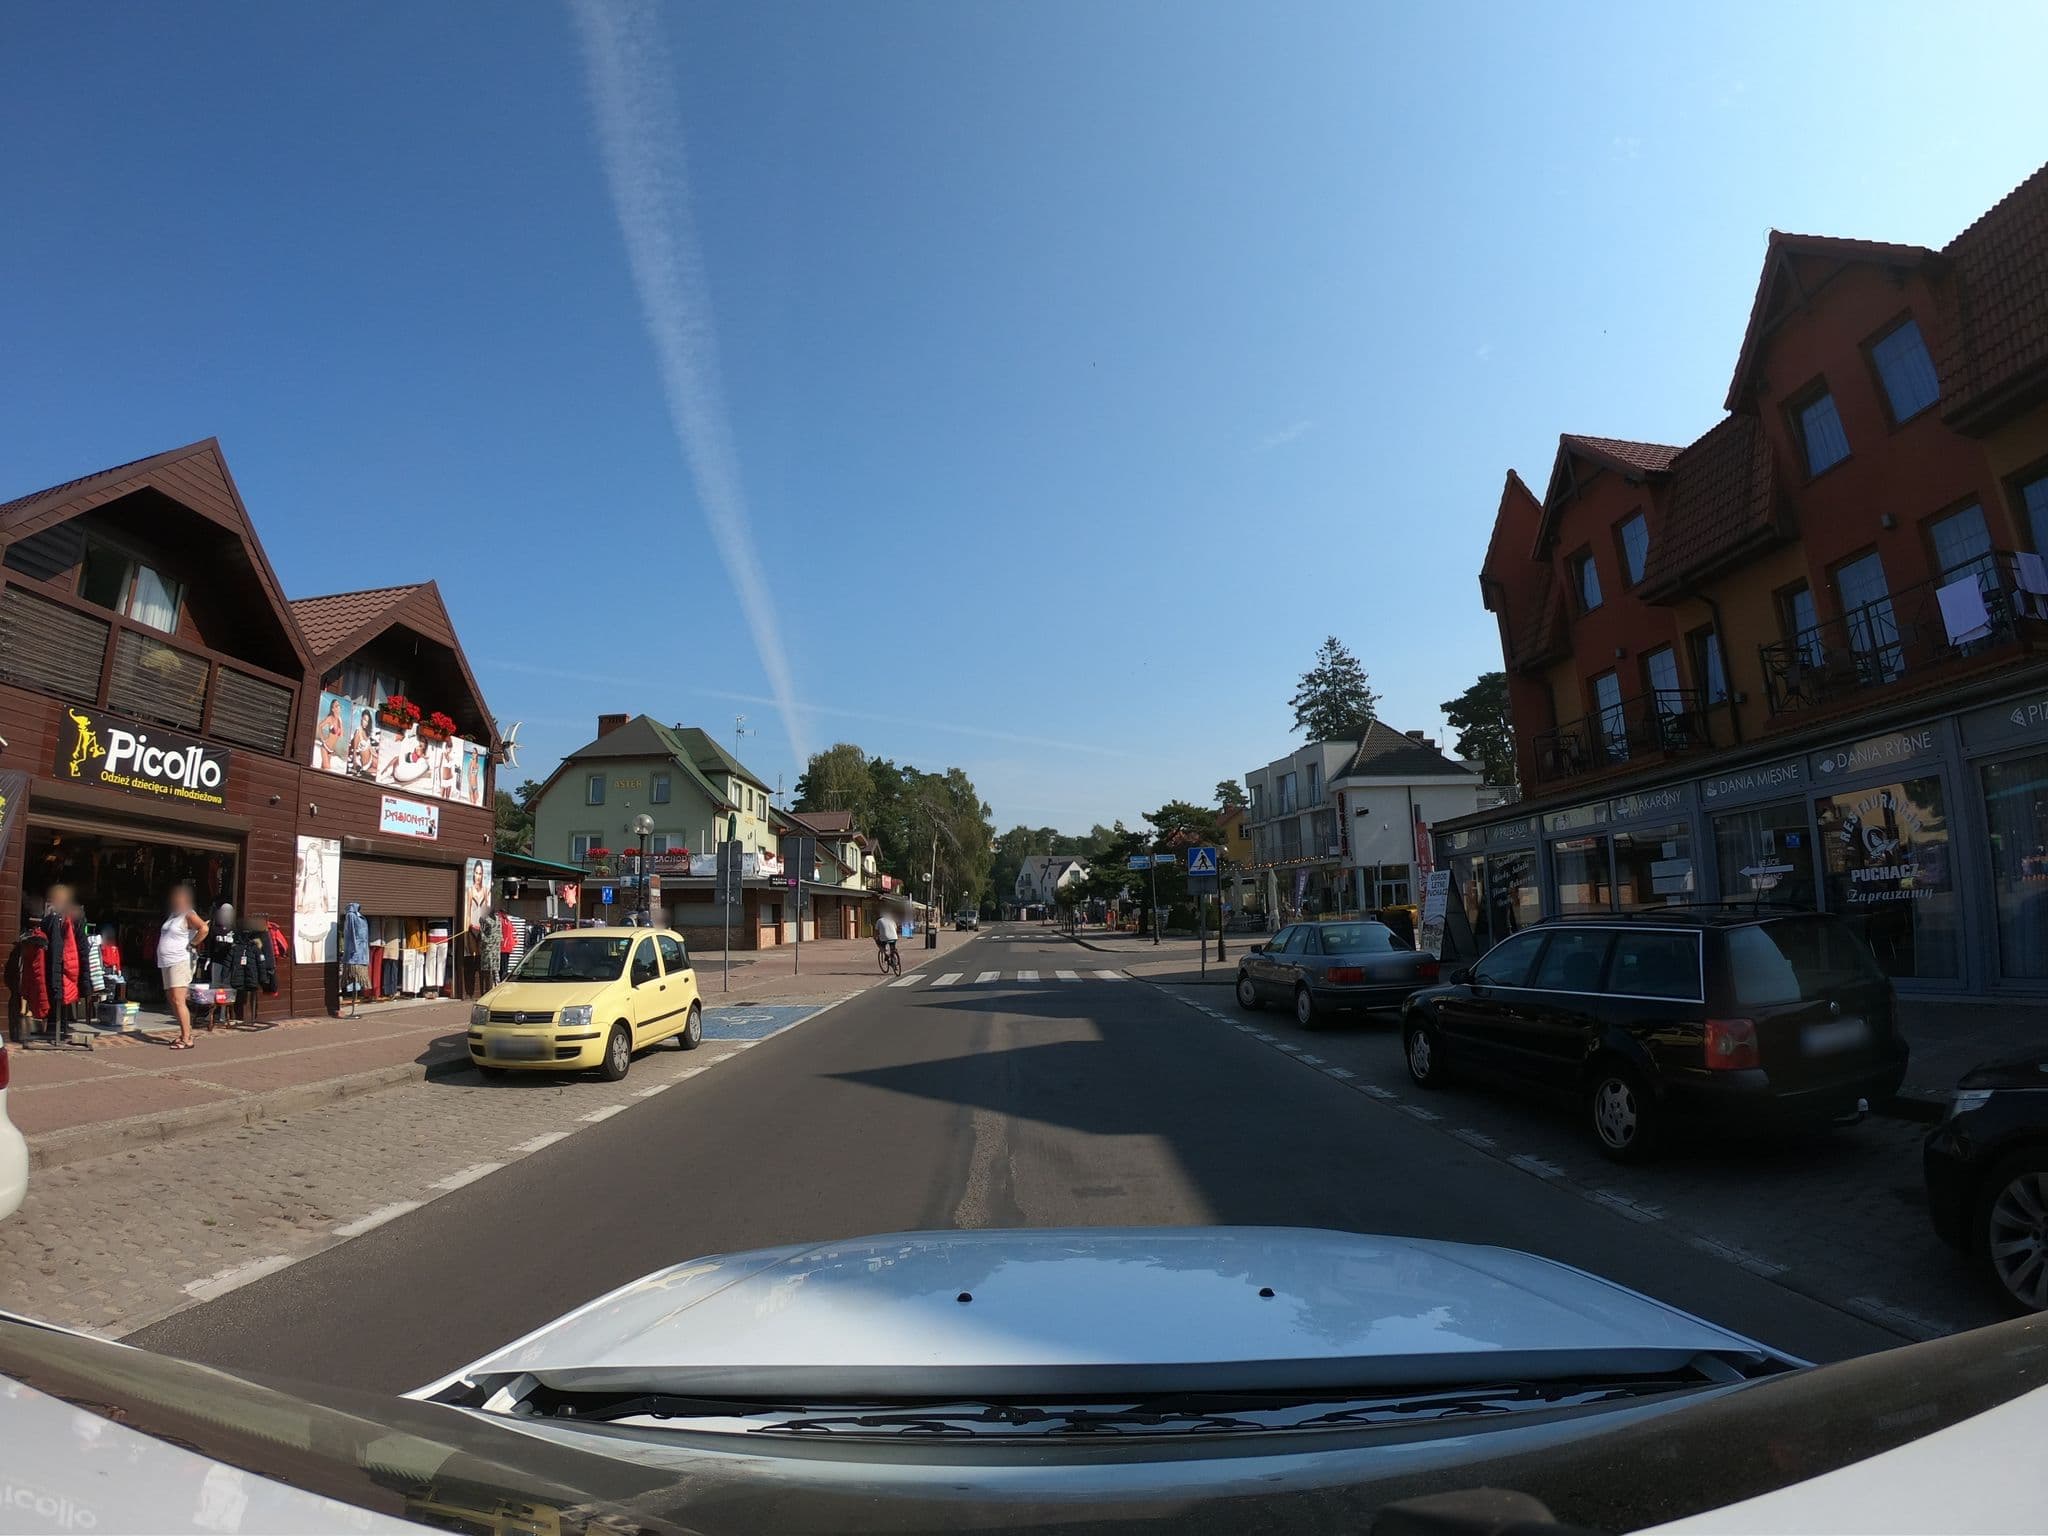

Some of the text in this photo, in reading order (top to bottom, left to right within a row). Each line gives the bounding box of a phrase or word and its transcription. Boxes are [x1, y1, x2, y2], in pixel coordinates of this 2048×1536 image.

[104, 728, 221, 789] Picollo
[1836, 731, 1933, 768] DANIA RYBNE
[100, 770, 130, 786] Odzież
[131, 777, 169, 794] dziecięca
[174, 787, 222, 804] młodzieżowa
[1719, 778, 1755, 795] DANIA
[1851, 863, 1921, 883] PUCHACZ
[1846, 887, 1936, 905] Zapraszamy
